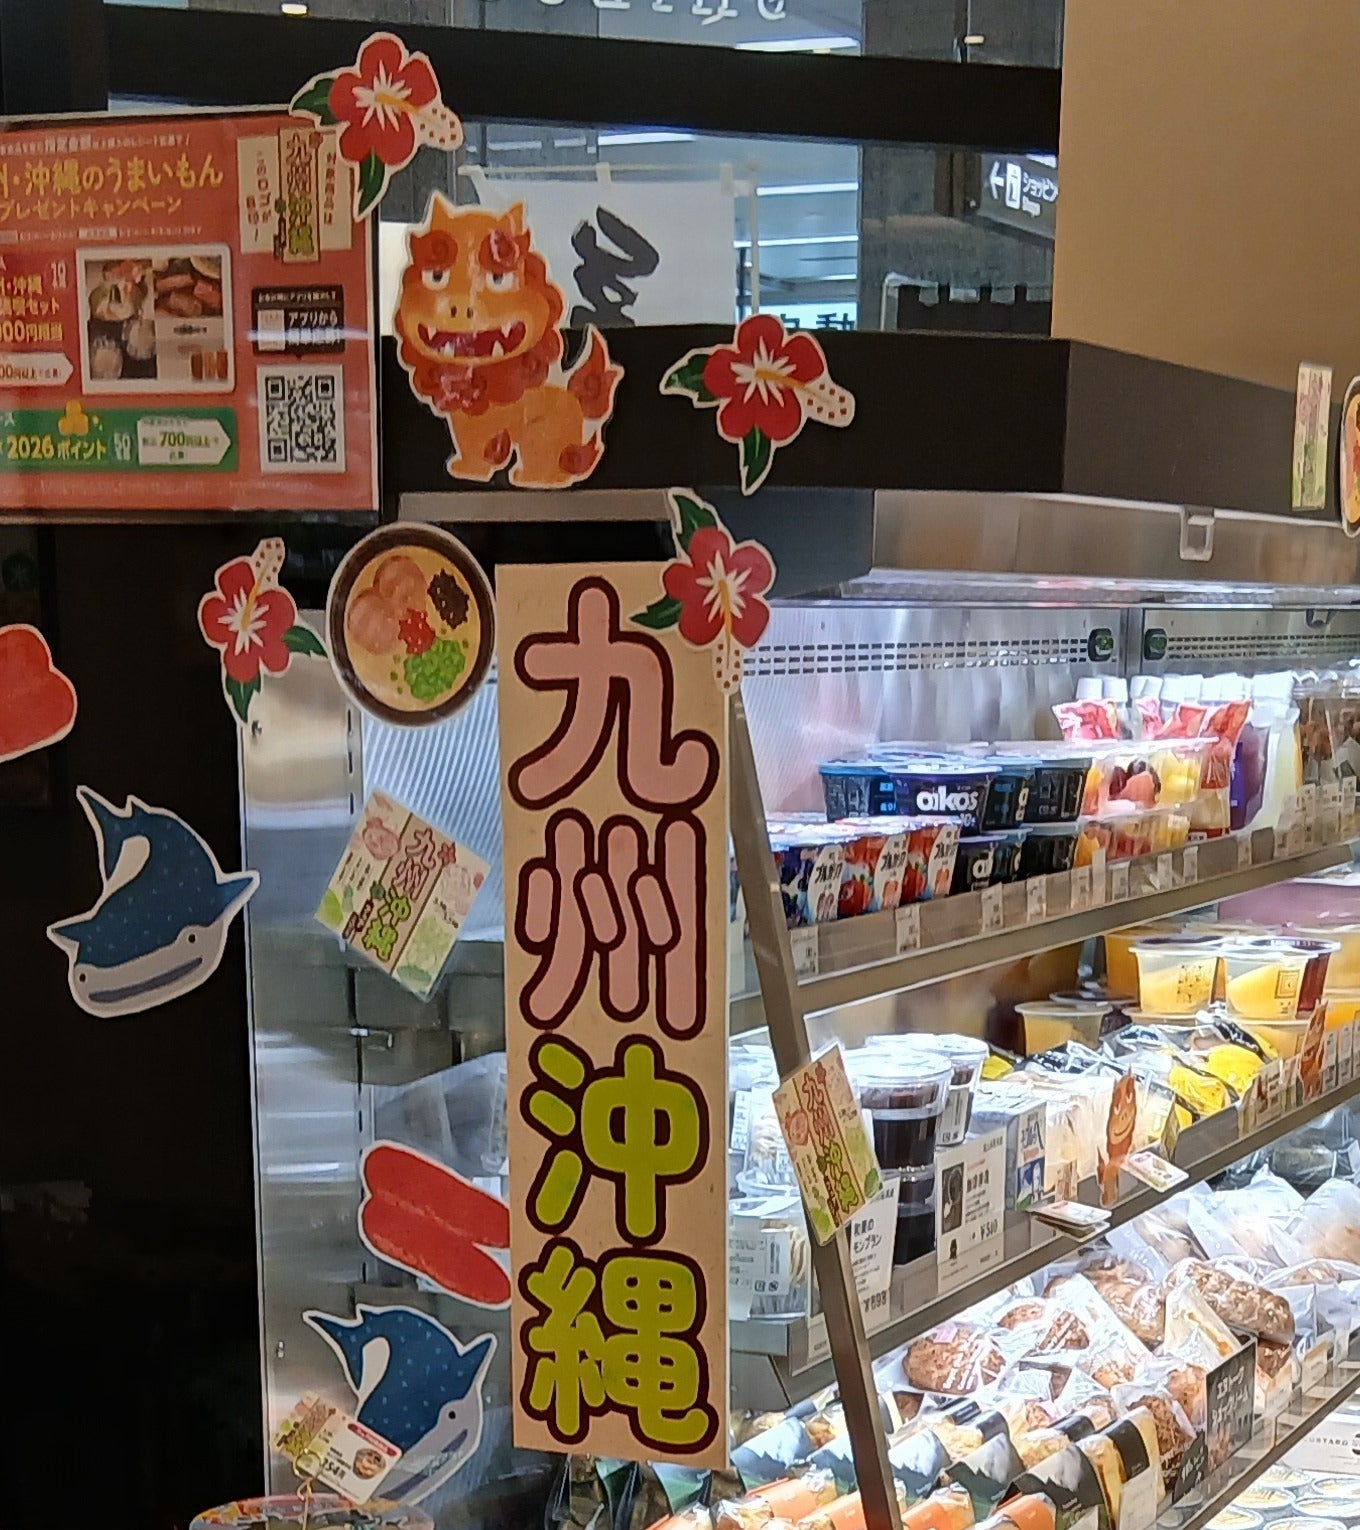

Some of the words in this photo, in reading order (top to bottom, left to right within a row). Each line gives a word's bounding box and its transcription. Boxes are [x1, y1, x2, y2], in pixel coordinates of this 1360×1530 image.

[6, 434, 55, 462] 2026
[508, 575, 721, 1455] 九州沖縄
